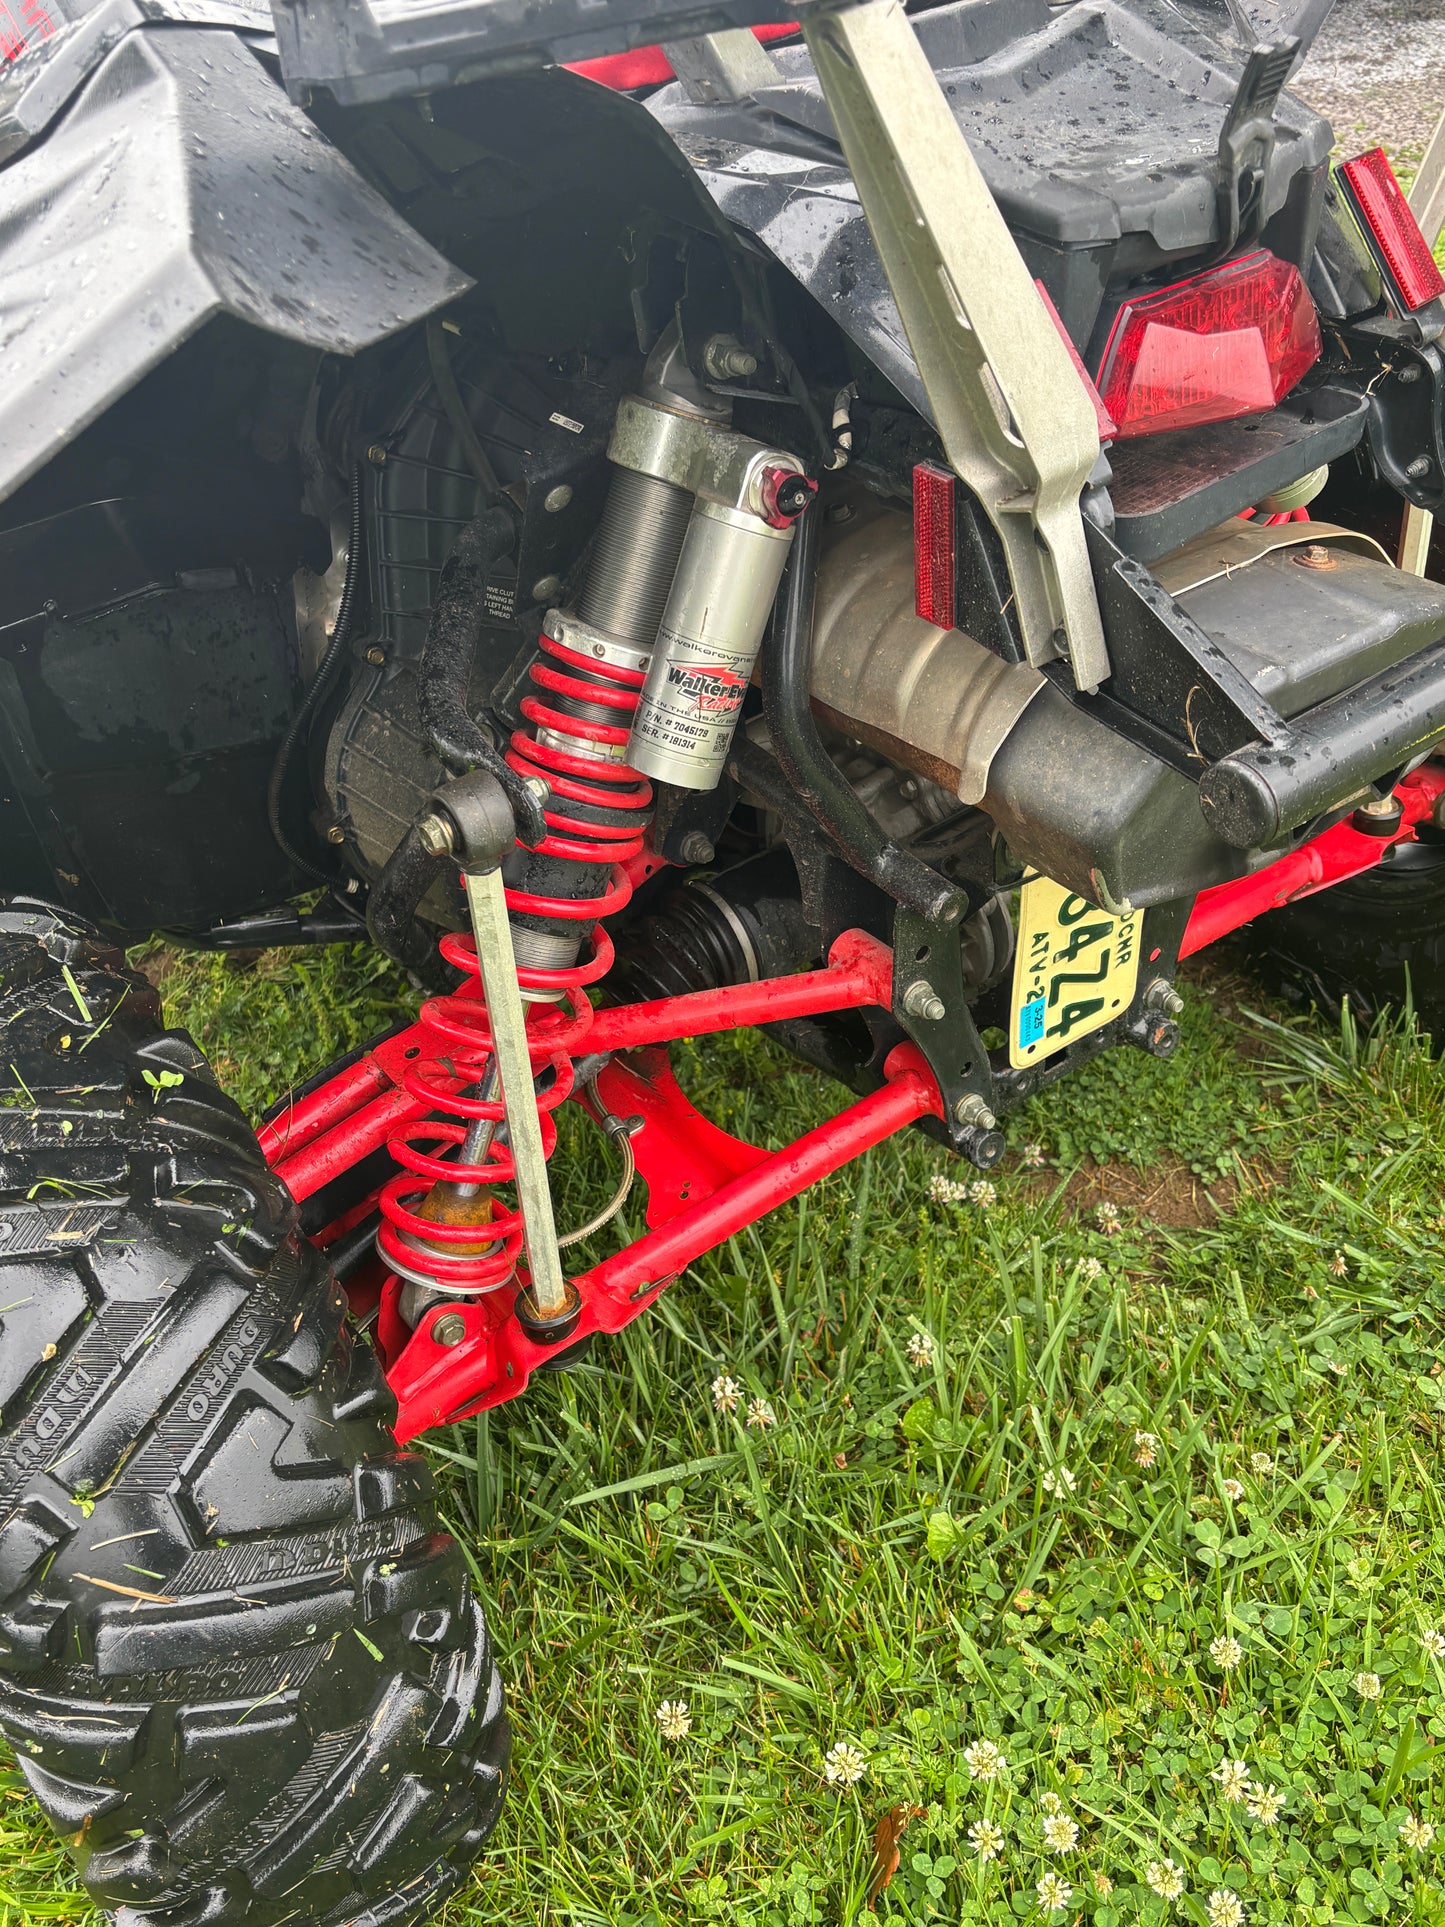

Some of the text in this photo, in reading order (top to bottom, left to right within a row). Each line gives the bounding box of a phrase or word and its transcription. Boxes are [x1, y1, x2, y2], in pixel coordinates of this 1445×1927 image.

[487, 601, 502, 609] LEFT
[488, 608, 511, 619] THREAD
[656, 699, 668, 708] IN
[671, 705, 691, 717] THE
[694, 713, 717, 724] USA
[641, 724, 659, 739] SER.
[1026, 931, 1049, 1004] ATV-2
[1034, 1004, 1044, 1030] 3-25
[187, 1317, 260, 1421] DURO
